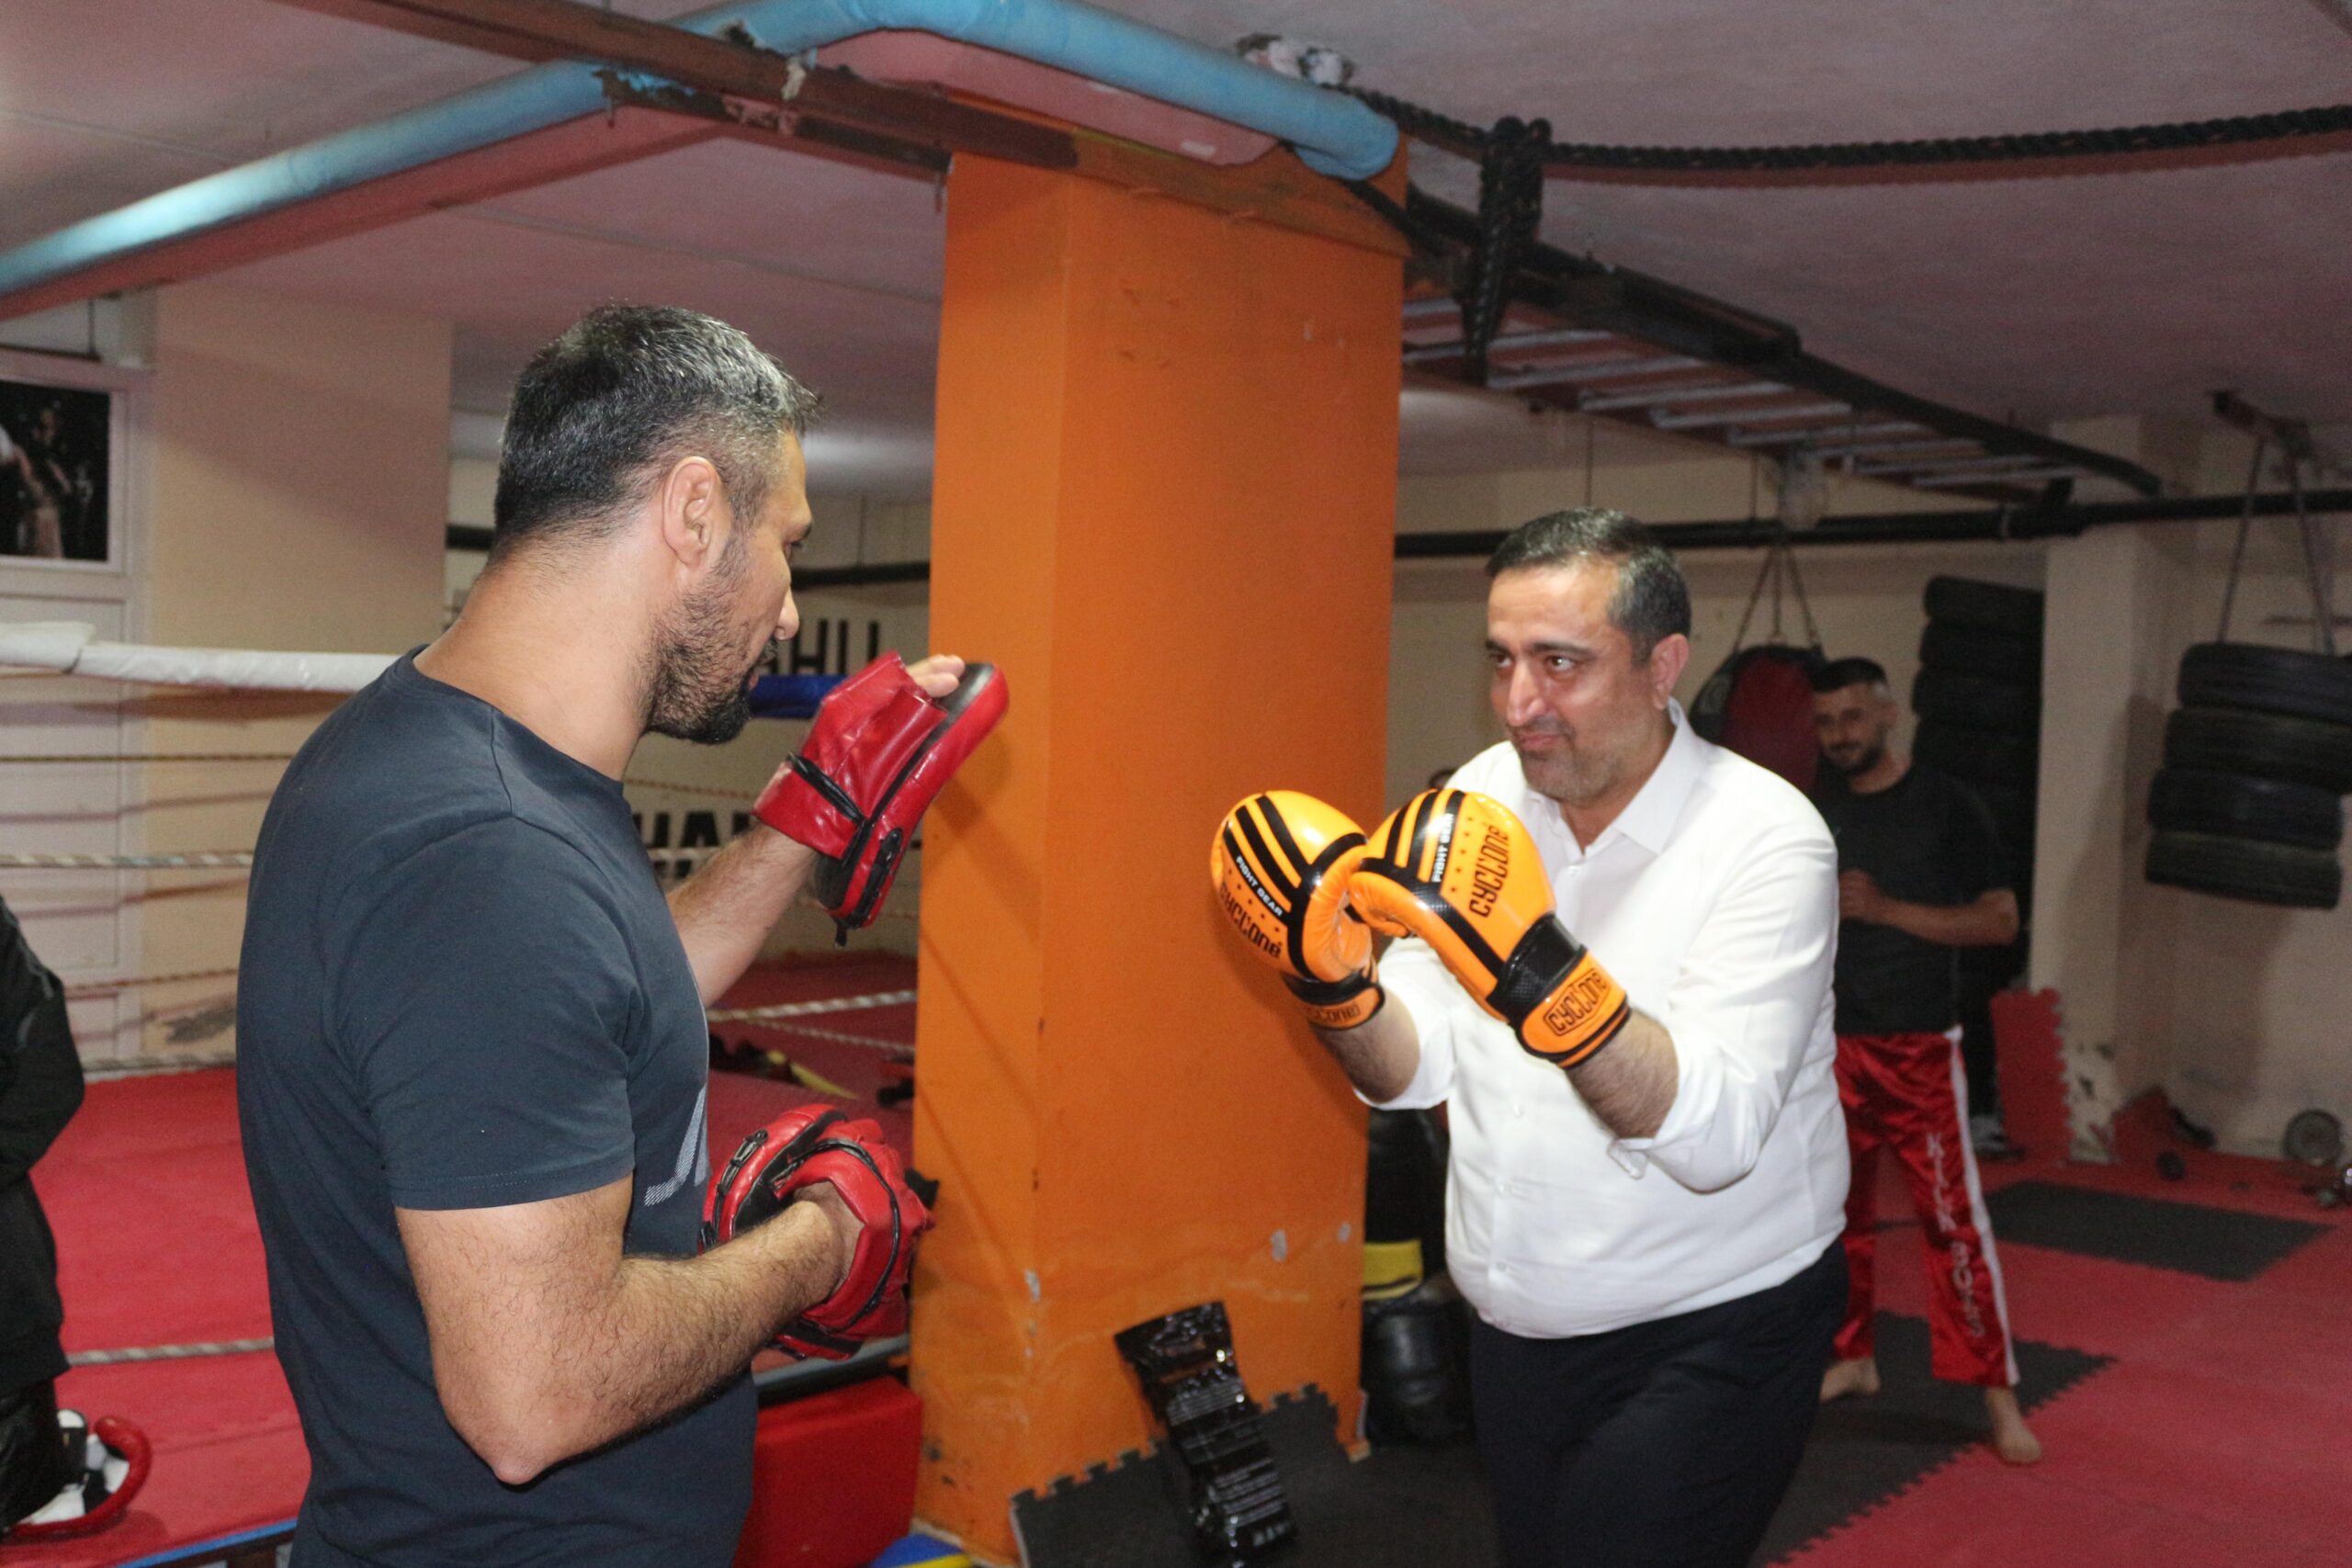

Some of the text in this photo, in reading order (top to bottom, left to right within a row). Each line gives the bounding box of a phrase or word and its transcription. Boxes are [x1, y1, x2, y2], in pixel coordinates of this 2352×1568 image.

[1236, 855, 1283, 917] FIGHT GEAR
[1431, 845, 1449, 883] FIGHT
